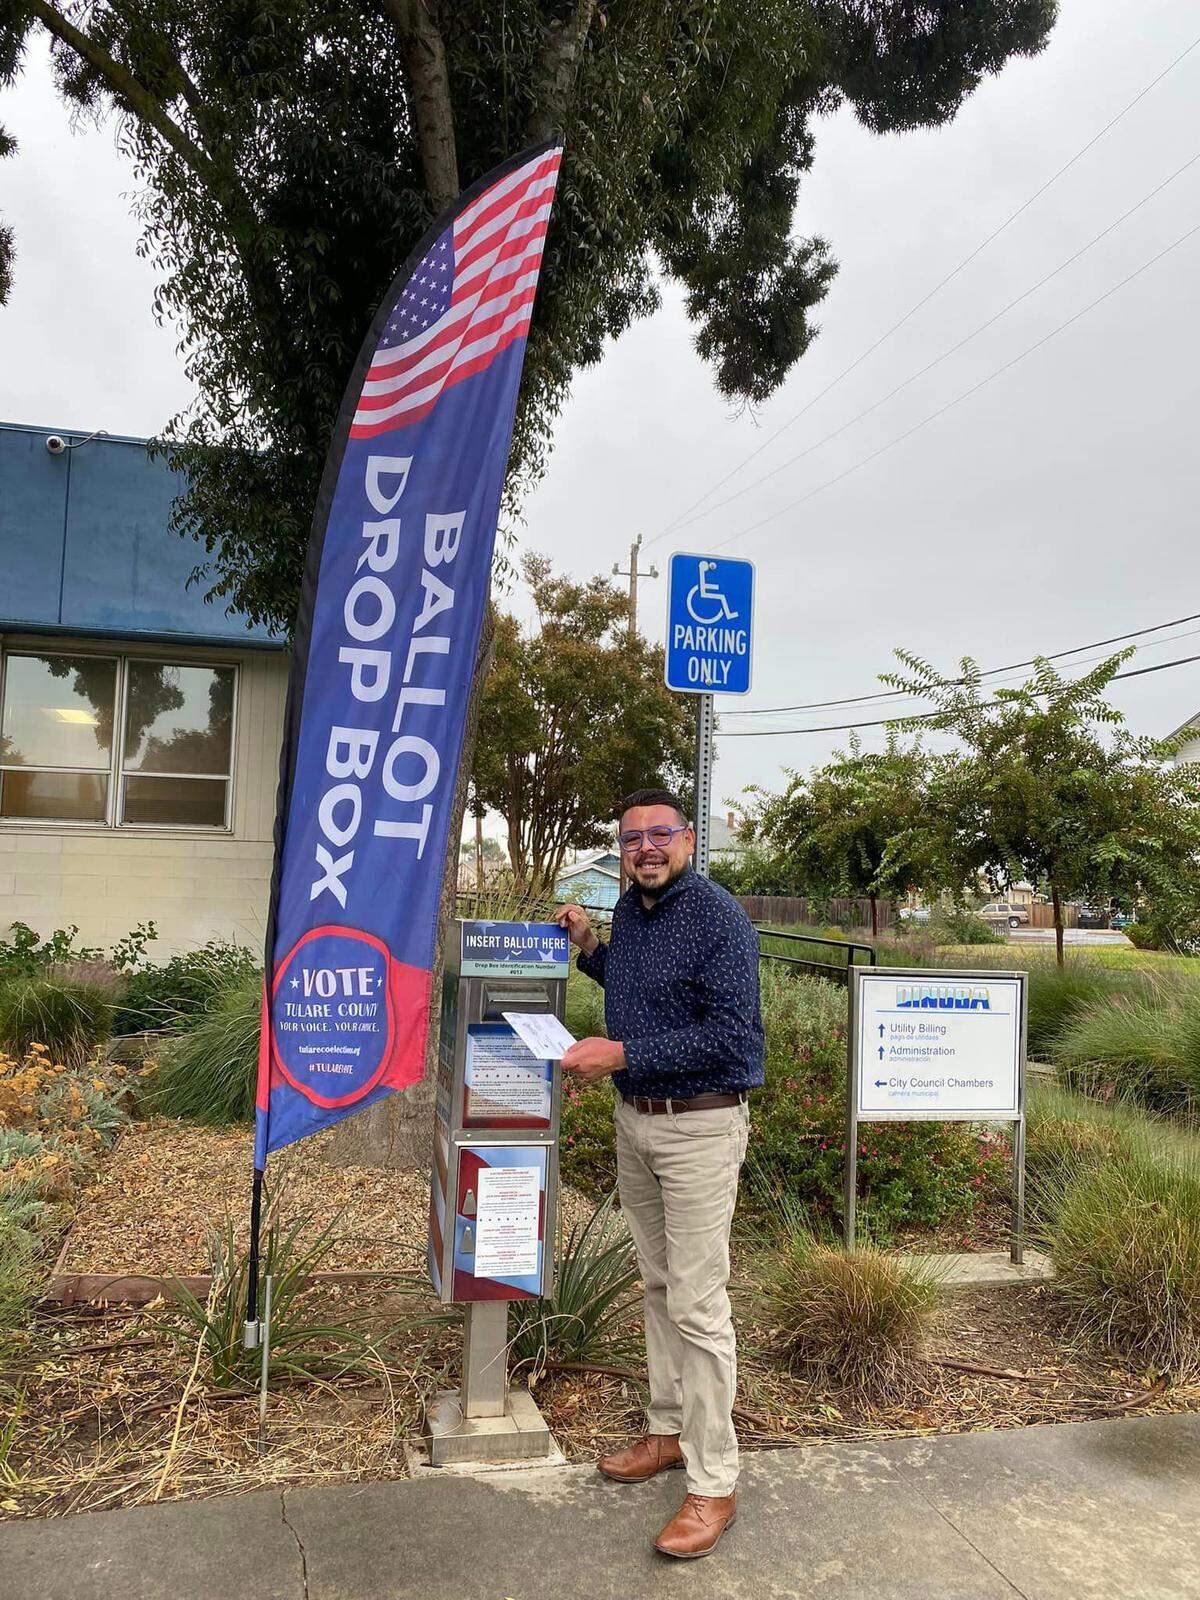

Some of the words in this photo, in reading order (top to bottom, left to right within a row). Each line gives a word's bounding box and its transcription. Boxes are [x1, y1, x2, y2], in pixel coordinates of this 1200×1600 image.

[338, 455, 413, 703] DROP
[674, 624, 747, 655] PARKING
[688, 656, 732, 684] ONLY
[374, 510, 466, 860] BALLOT
[309, 725, 381, 910] BOX
[466, 935, 501, 948] INSERT
[504, 936, 540, 949] BALLOT
[542, 937, 566, 950] HERE
[302, 967, 375, 998] VOTE
[896, 984, 992, 1010] DINUBA
[285, 1003, 332, 1018] TULARE
[280, 1021, 298, 1032] YOUR
[300, 1022, 332, 1032] VOICE.
[335, 1021, 358, 1032] YOUR
[890, 1023, 916, 1034] Utility
[919, 1023, 947, 1036] Billing
[890, 1045, 955, 1056] Administration
[889, 1077, 907, 1089] City
[910, 1077, 945, 1088] Council
[947, 1077, 994, 1088] Chambers
